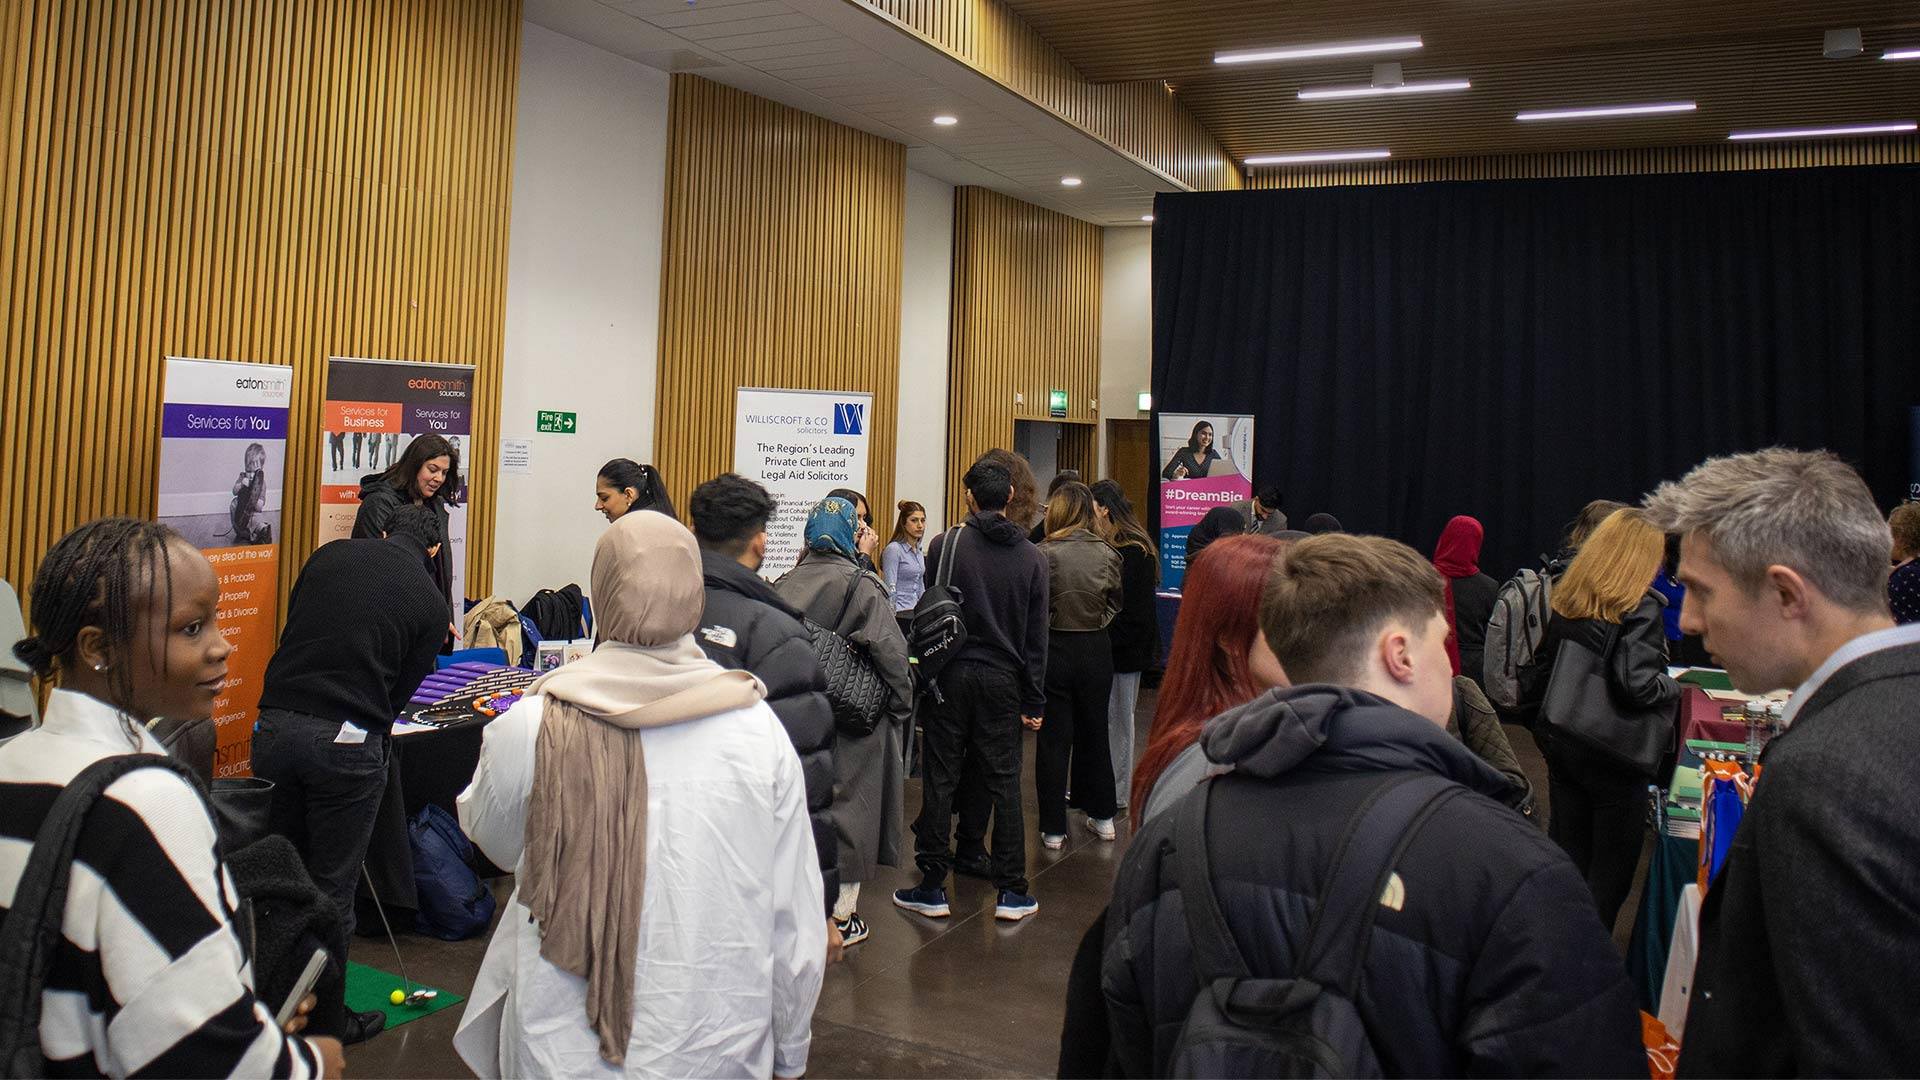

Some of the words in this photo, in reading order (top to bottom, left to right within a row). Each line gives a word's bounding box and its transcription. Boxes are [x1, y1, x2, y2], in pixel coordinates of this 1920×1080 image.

[408, 377, 466, 390] eatonsmith
[340, 405, 376, 416] Services
[376, 407, 388, 417] for
[415, 408, 449, 419] Services
[450, 410, 461, 420] for
[541, 412, 553, 421] Fire
[187, 413, 232, 430] Services
[234, 415, 248, 430] for
[249, 416, 270, 430] You
[343, 416, 385, 428] Business
[428, 419, 447, 430] You
[745, 415, 802, 425] WILLISCROFT
[805, 416, 811, 426] &
[815, 416, 828, 426] CO
[541, 423, 552, 431] exit
[797, 426, 828, 435] solicitors
[757, 443, 775, 453] The
[820, 445, 855, 457] Leading
[765, 456, 798, 467] Private
[800, 457, 826, 468] Client
[829, 459, 846, 468] and
[761, 470, 786, 482] Legal
[788, 470, 805, 481] Aid
[808, 470, 849, 481] Solicitors
[339, 490, 356, 499] with
[224, 590, 251, 602] Property
[213, 711, 246, 727] egligence
